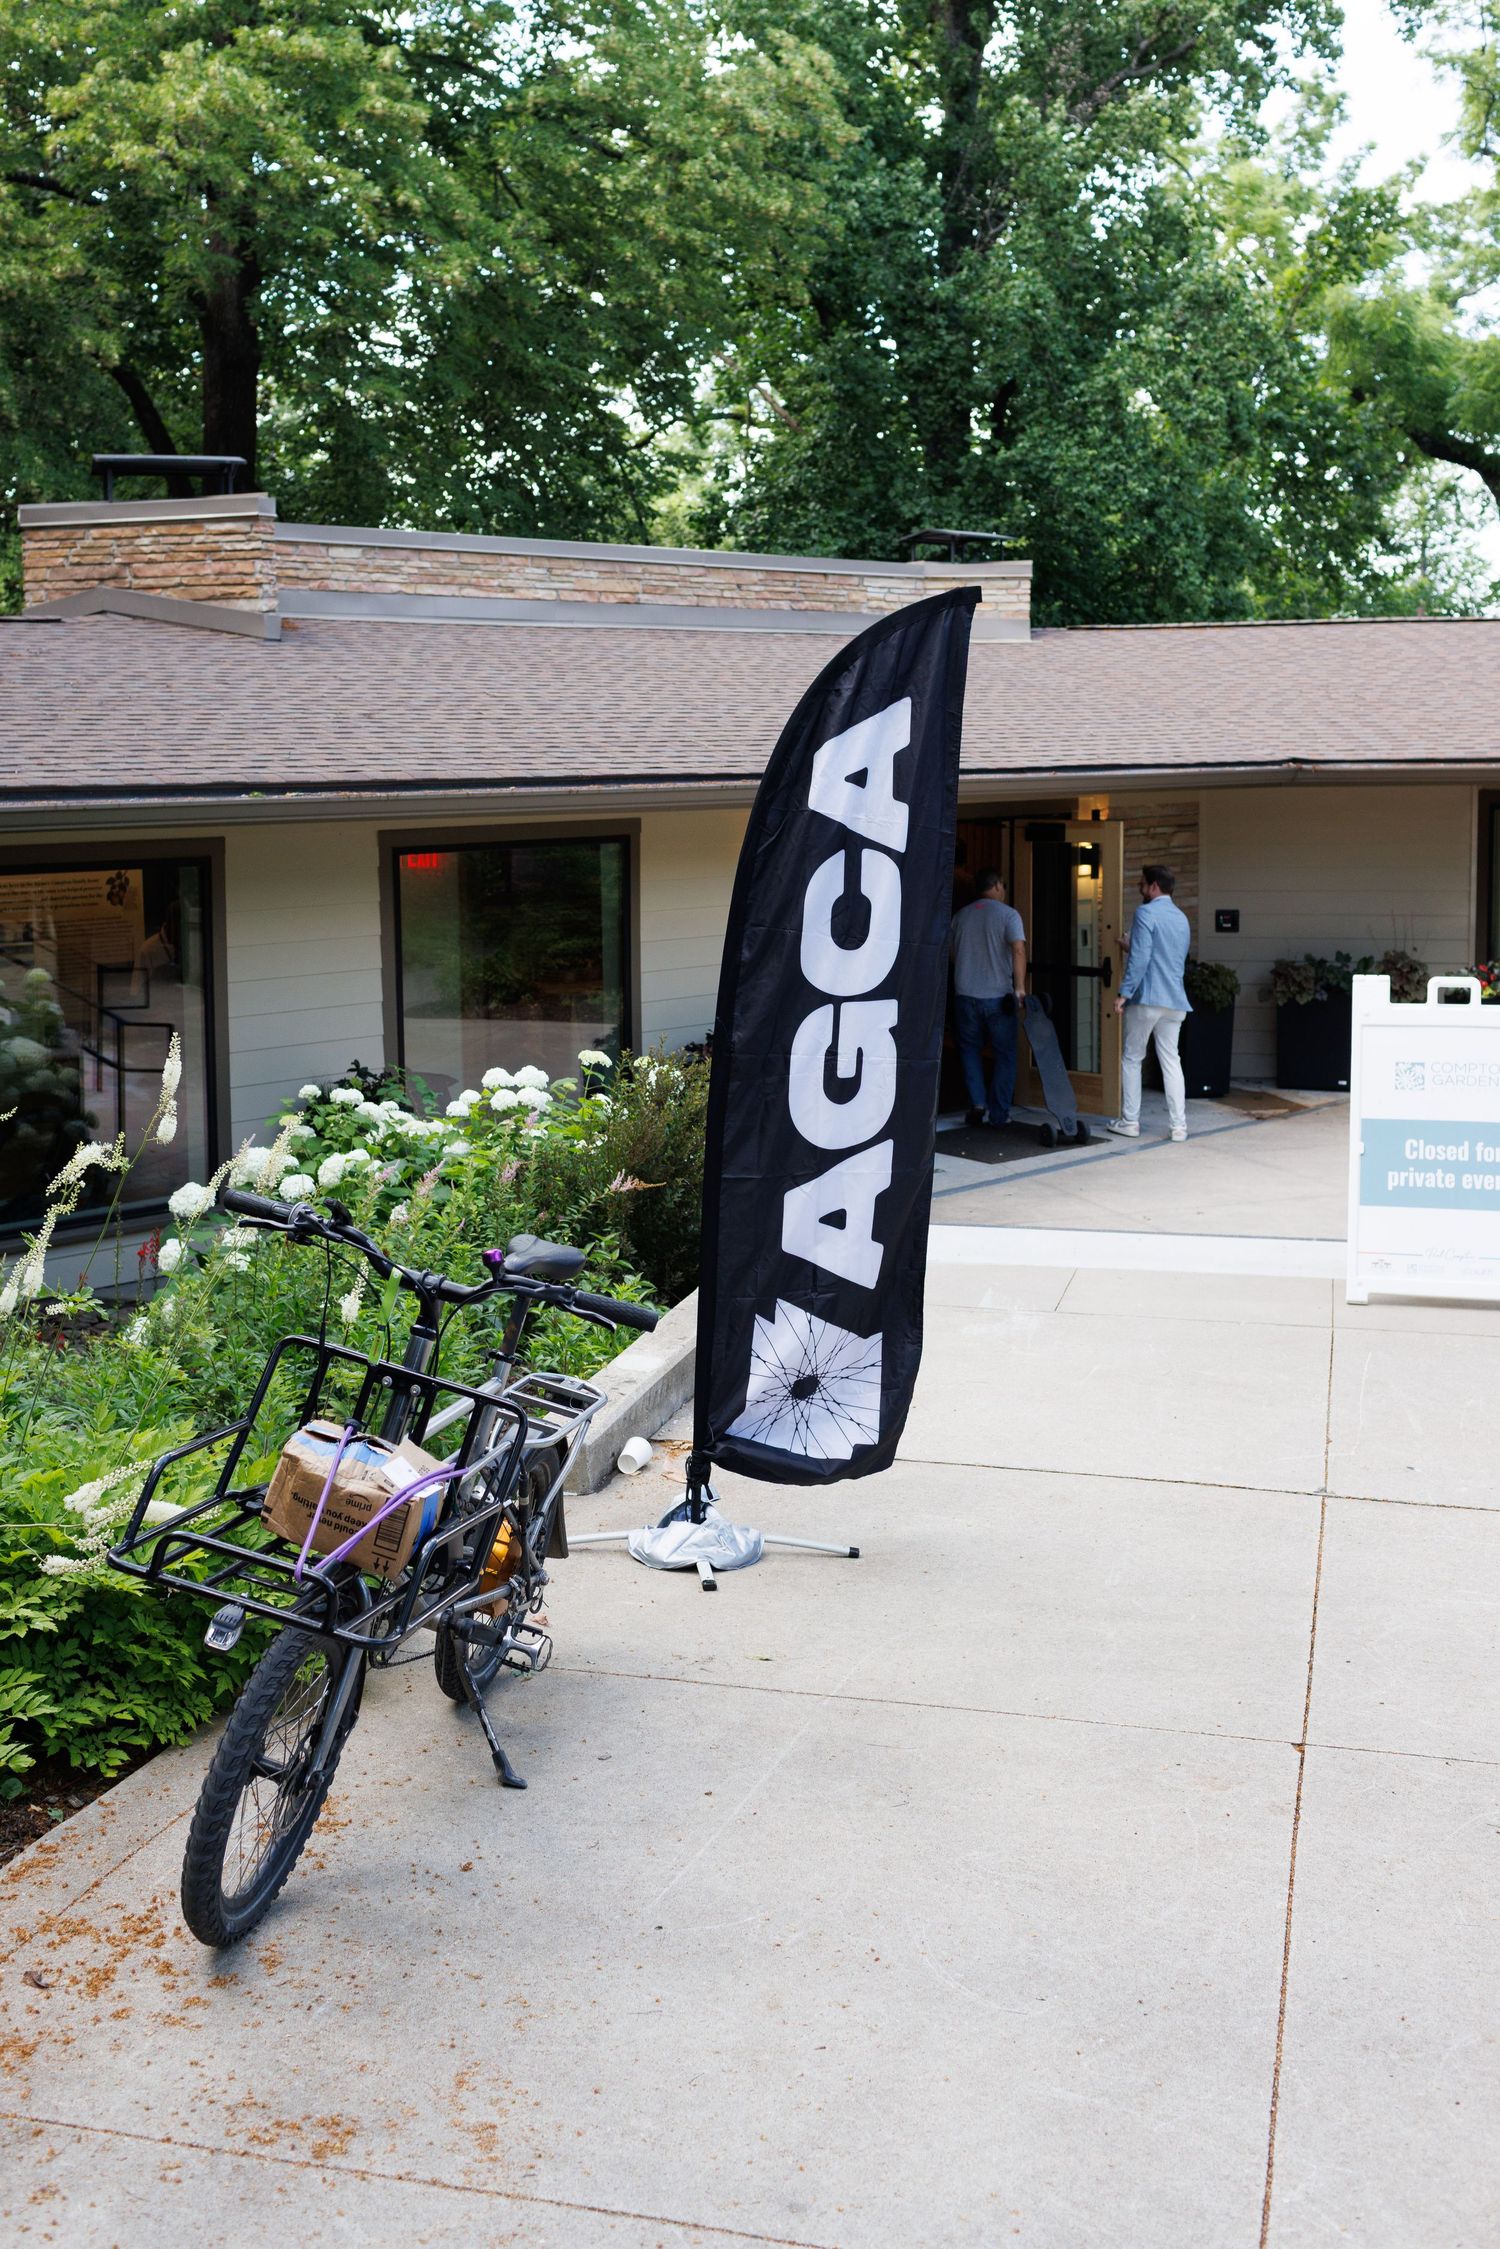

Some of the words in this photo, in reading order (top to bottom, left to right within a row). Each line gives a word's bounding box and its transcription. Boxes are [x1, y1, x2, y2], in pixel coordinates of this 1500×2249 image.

[781, 696, 912, 1290] AGCA
[1430, 1062, 1500, 1075] COMPTO
[1431, 1074, 1500, 1087] GARDEN
[1405, 1139, 1469, 1161] Closed
[1387, 1167, 1456, 1191] private
[291, 1491, 325, 1514] aiting.
[345, 1497, 373, 1512] prime
[306, 1511, 333, 1526] neer
[325, 1508, 344, 1519] you
